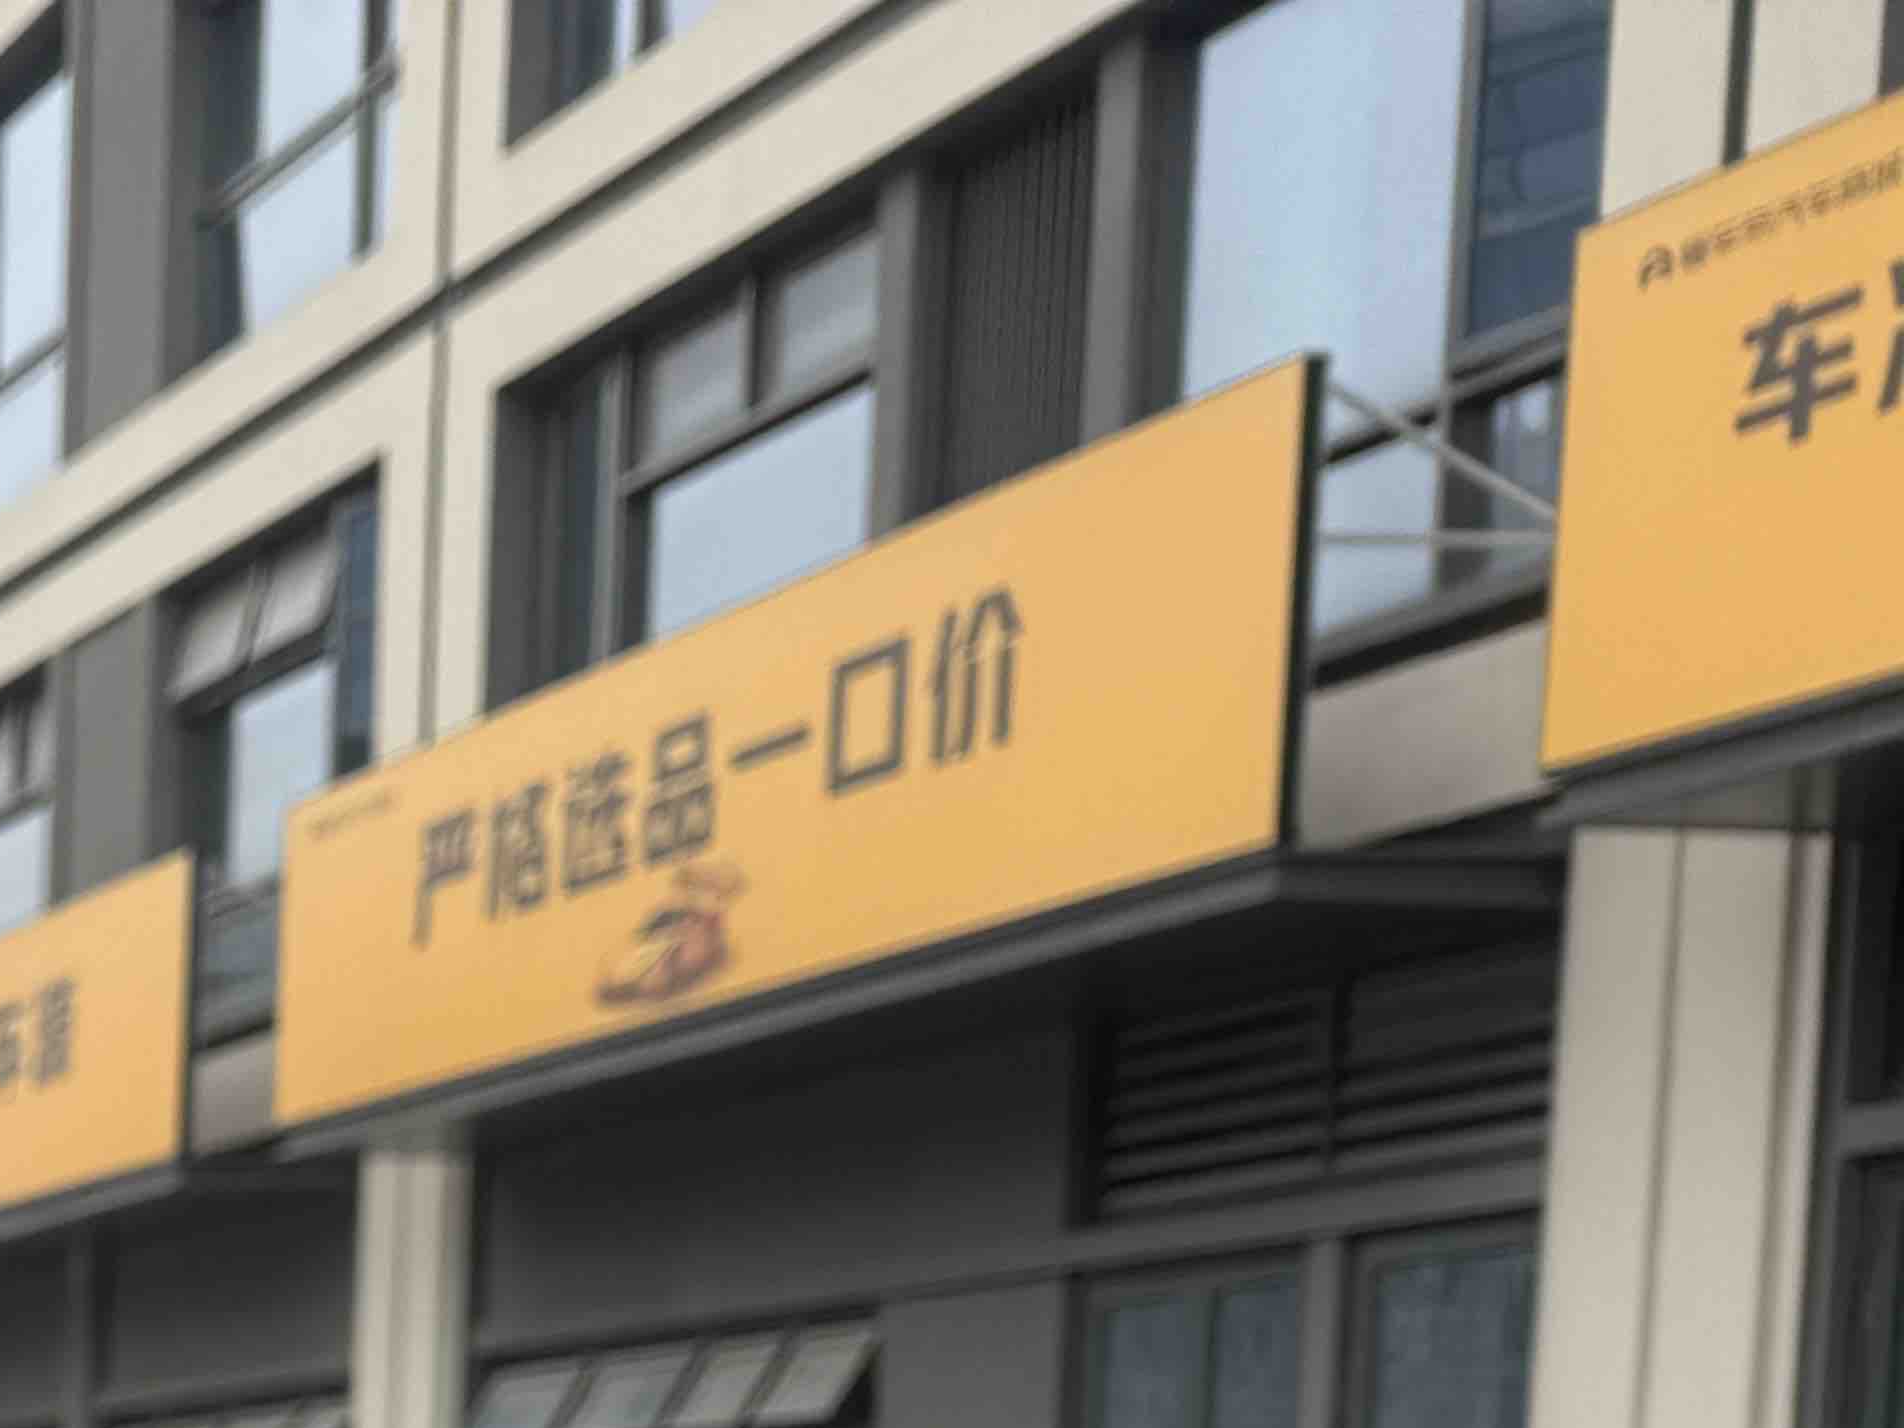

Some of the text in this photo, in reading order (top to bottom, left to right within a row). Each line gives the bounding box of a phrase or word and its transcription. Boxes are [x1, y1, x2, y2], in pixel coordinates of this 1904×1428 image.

[410, 588, 1023, 950] 严格选品一口价
